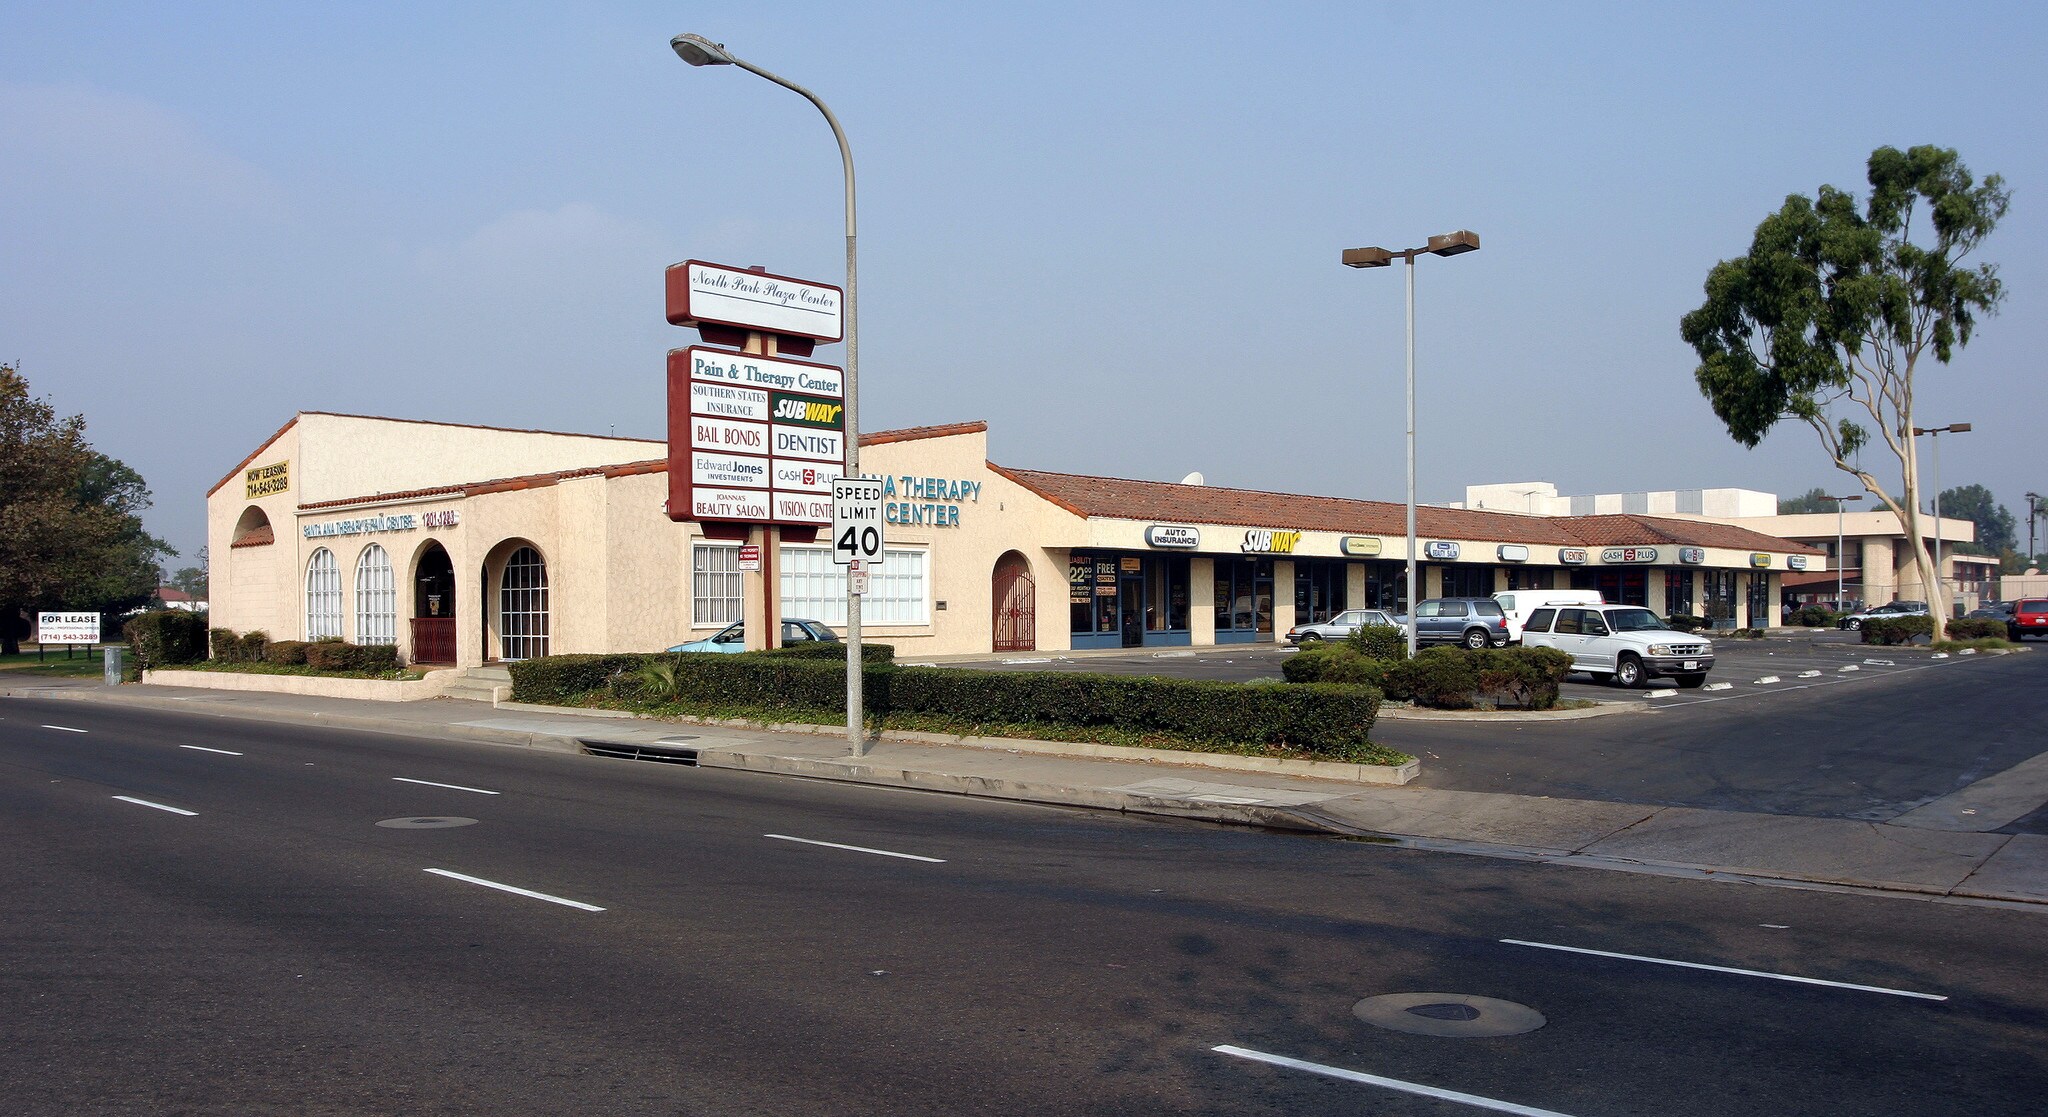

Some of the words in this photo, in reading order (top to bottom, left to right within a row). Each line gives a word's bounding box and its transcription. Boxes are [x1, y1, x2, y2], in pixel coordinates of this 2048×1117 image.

[693, 270, 729, 288] North
[731, 276, 761, 294] Park
[763, 281, 797, 304] Plaza
[799, 288, 835, 308] Center
[695, 358, 724, 378] Pain
[728, 363, 740, 380] &
[744, 365, 795, 389] Therapy
[798, 373, 839, 393] Center
[693, 385, 736, 400] SOUTHERN
[737, 390, 766, 403] STATES
[707, 402, 754, 416] INSURANCE
[773, 399, 842, 424] SUBWAY
[697, 425, 720, 444] BAIL
[724, 428, 761, 447] BONDS
[778, 433, 837, 455] DENTIST
[696, 459, 732, 472] Edward
[732, 461, 763, 475] Jones
[707, 473, 754, 482] INVESTMENTS
[778, 470, 801, 481] CASH
[836, 487, 880, 500] SPEED
[900, 475, 981, 502] THERAPY
[716, 494, 746, 502] JOANNA'S
[696, 502, 733, 516] BEAUTY
[736, 504, 766, 520] SALON
[779, 500, 807, 517] VISION
[809, 502, 833, 518] CENTE
[840, 507, 876, 520] LIMIT
[885, 502, 960, 526] CENTER
[303, 523, 322, 537] SANTA
[837, 526, 880, 557] 40
[1154, 535, 1197, 545] INSURANCE
[1240, 529, 1301, 553] SUBWAY
[1565, 551, 1585, 561] DENTIST
[1603, 552, 1623, 560] CASH
[1636, 551, 1655, 559] PLUS
[1096, 562, 1116, 574] FREE
[41, 615, 62, 623] FOR
[64, 615, 97, 623] LEASE
[40, 633, 61, 641] (714)
